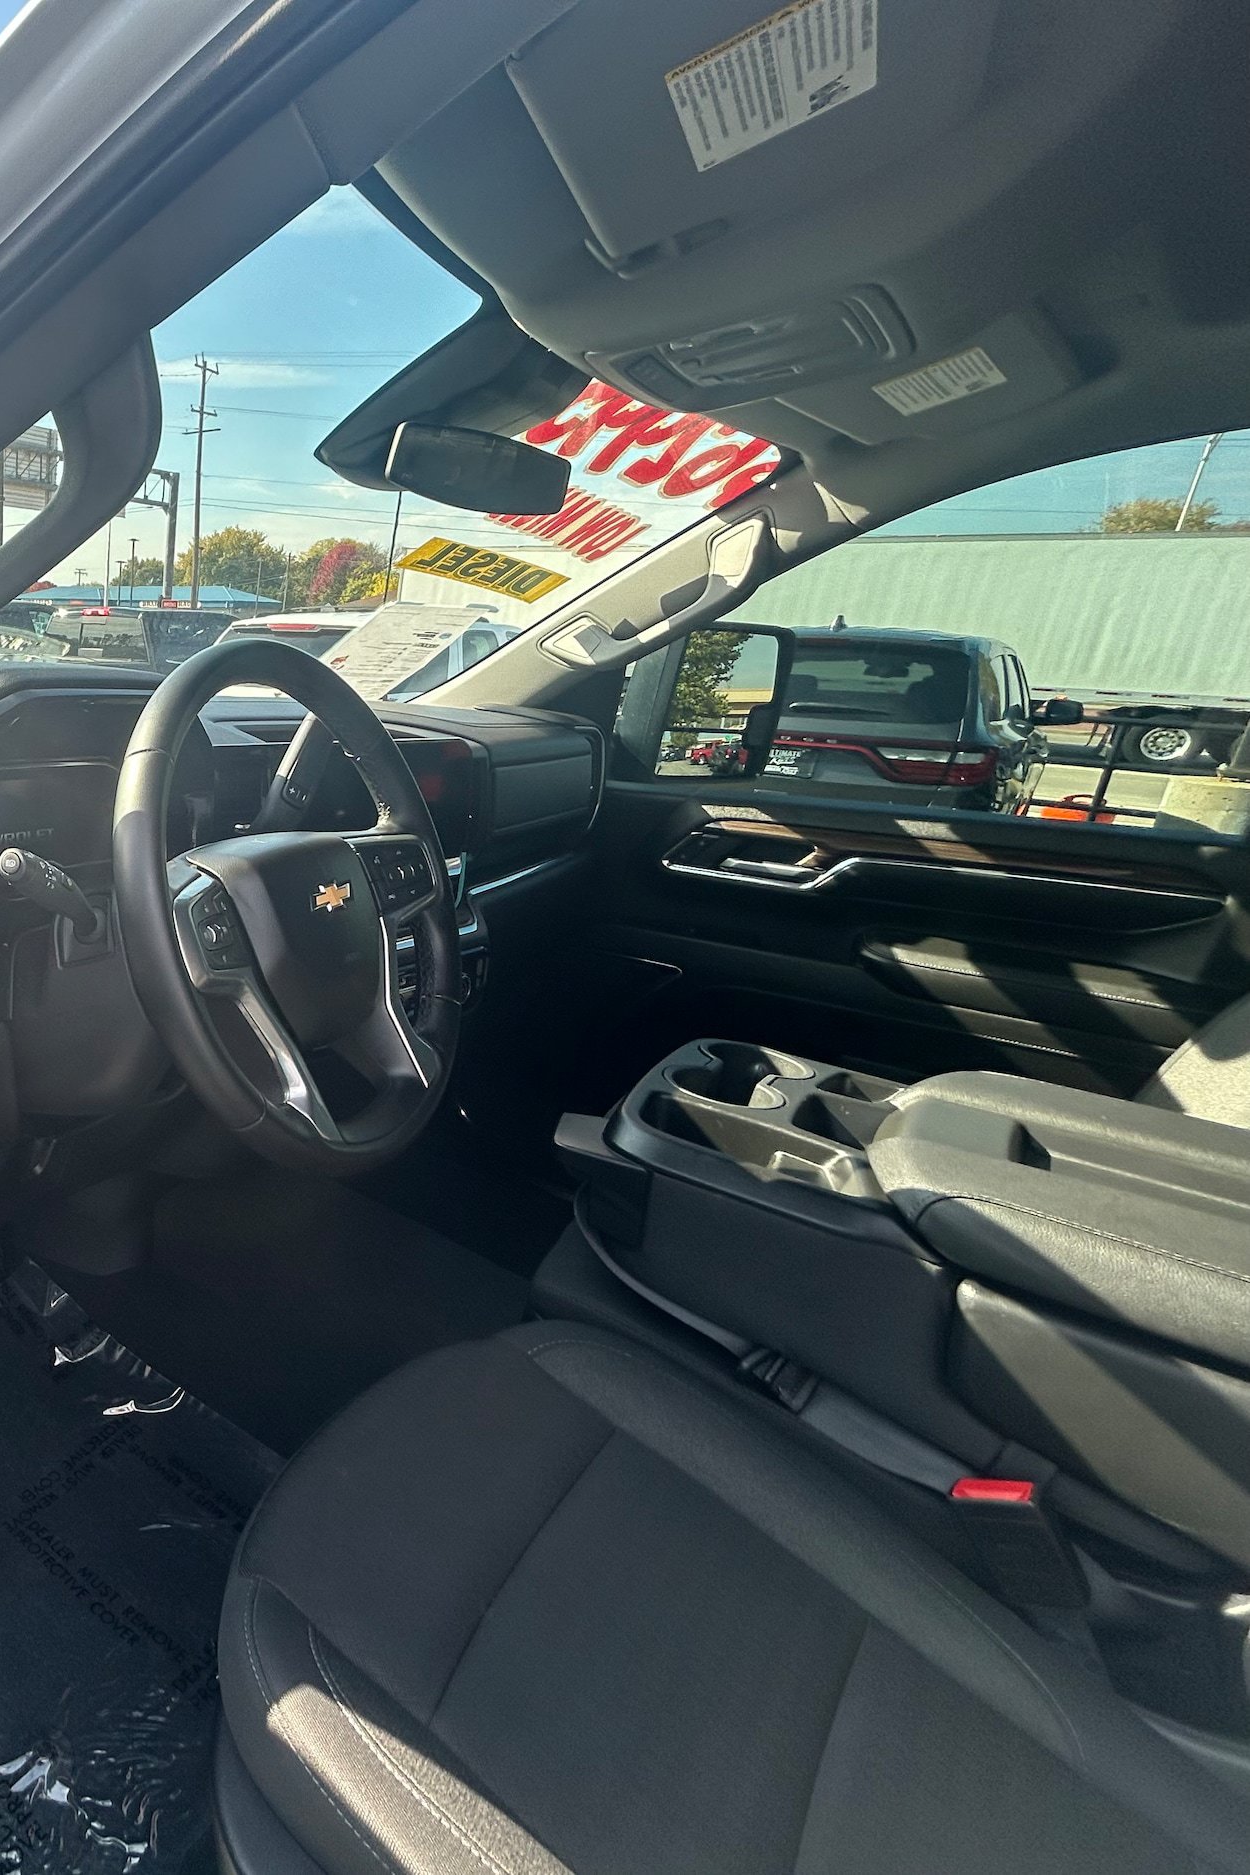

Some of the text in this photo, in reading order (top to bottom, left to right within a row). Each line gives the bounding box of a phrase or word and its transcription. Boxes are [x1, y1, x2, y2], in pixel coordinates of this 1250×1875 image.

[28, 1521, 188, 1663] DEALER MUST REMOVE
[90, 1601, 140, 1646] COVER
